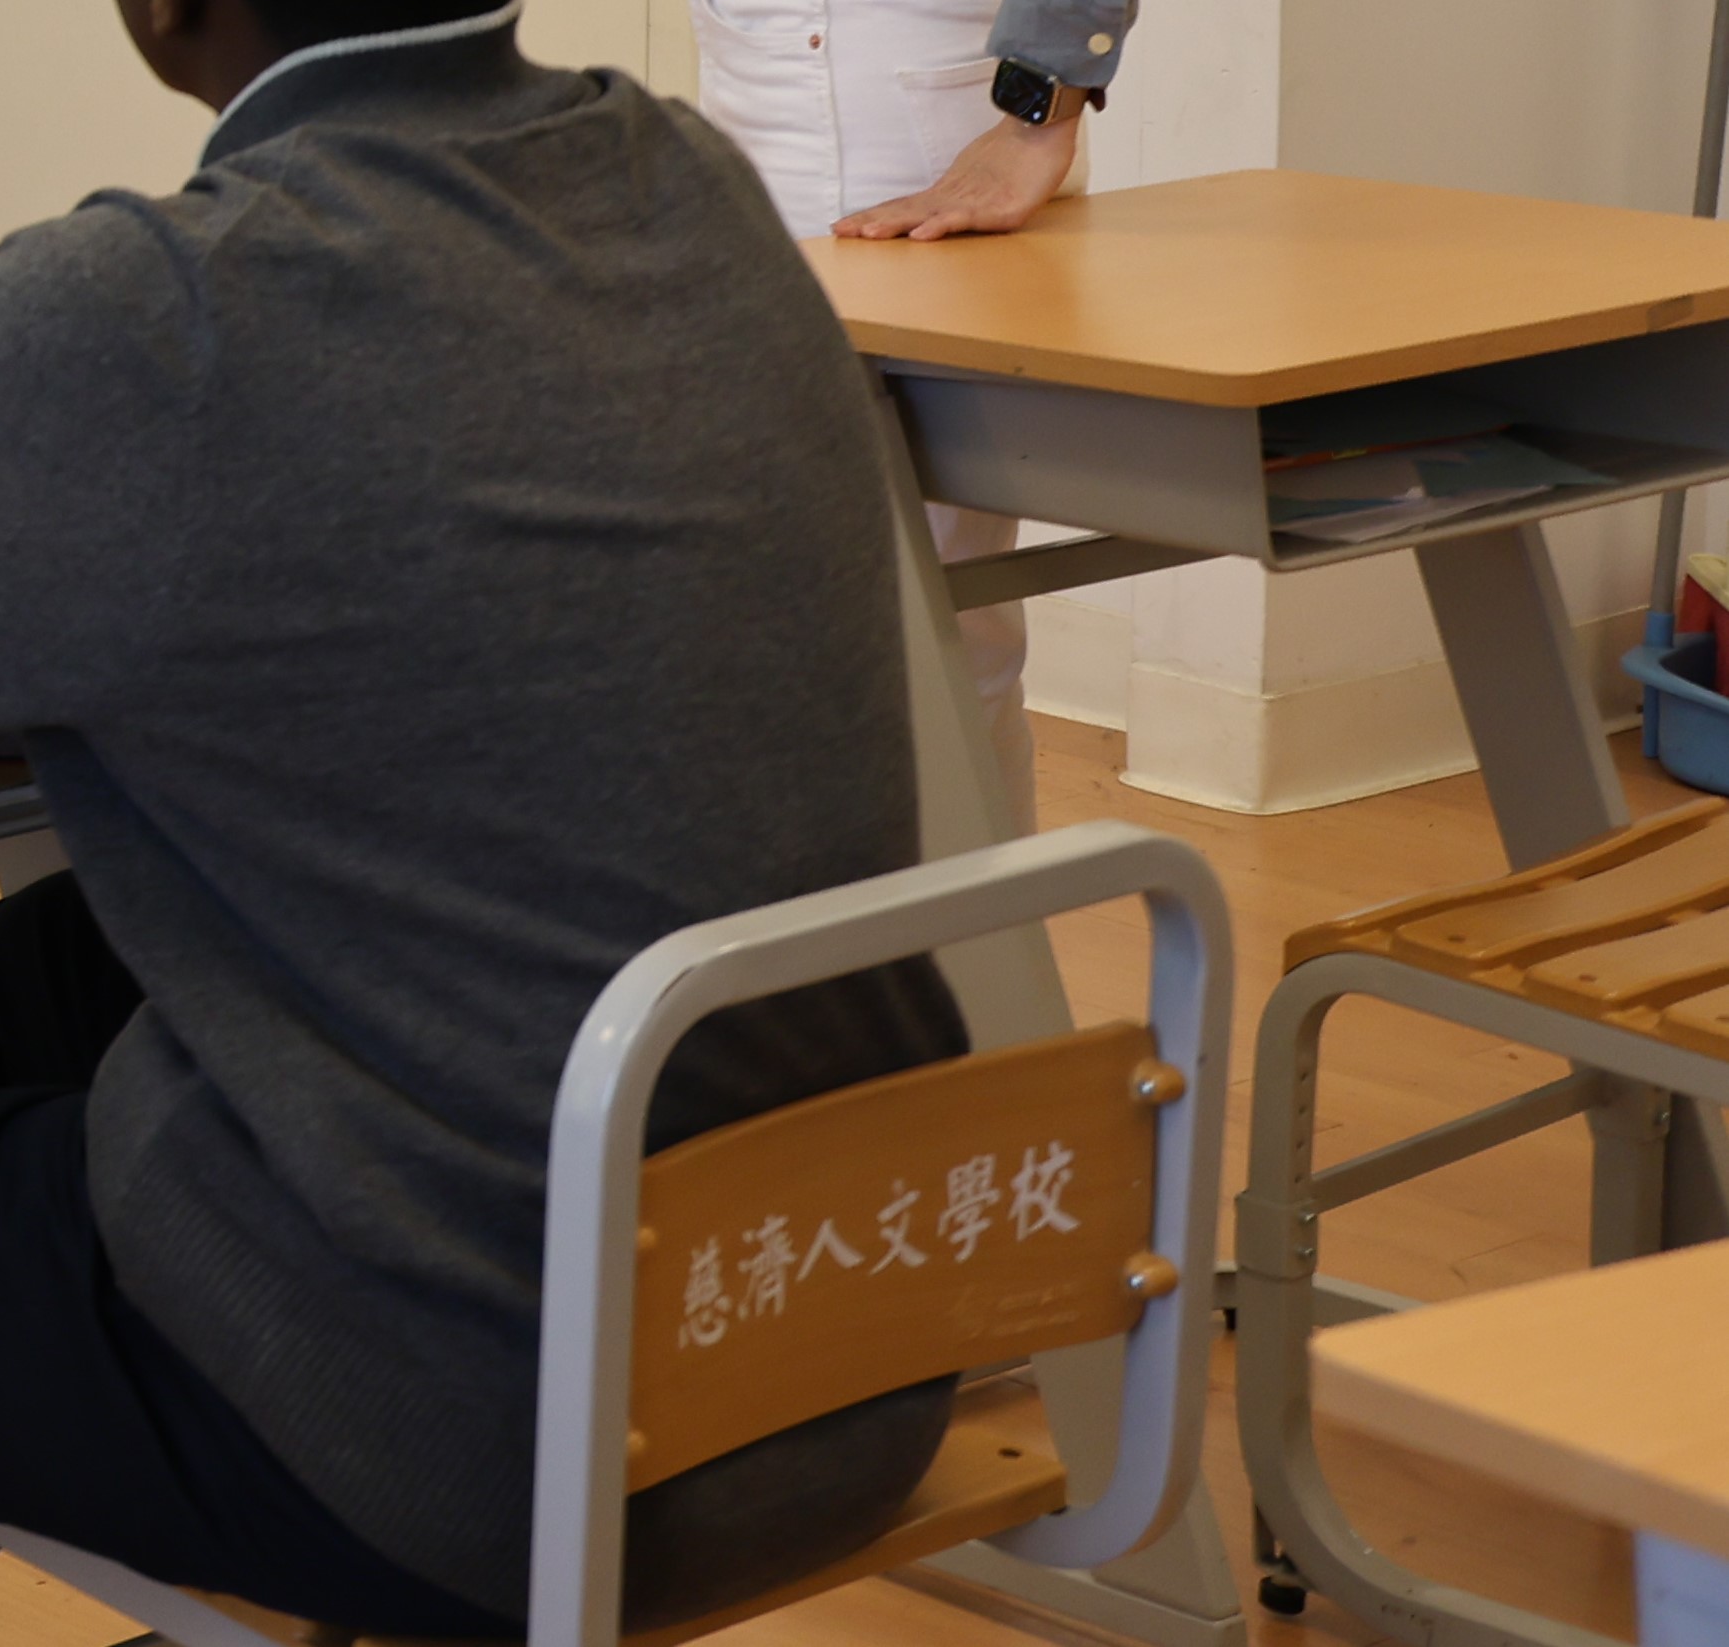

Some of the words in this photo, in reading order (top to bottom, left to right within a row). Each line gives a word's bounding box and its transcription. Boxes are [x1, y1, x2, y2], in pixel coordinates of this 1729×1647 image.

[677, 1140, 1083, 1351] 慈濟人文學校
